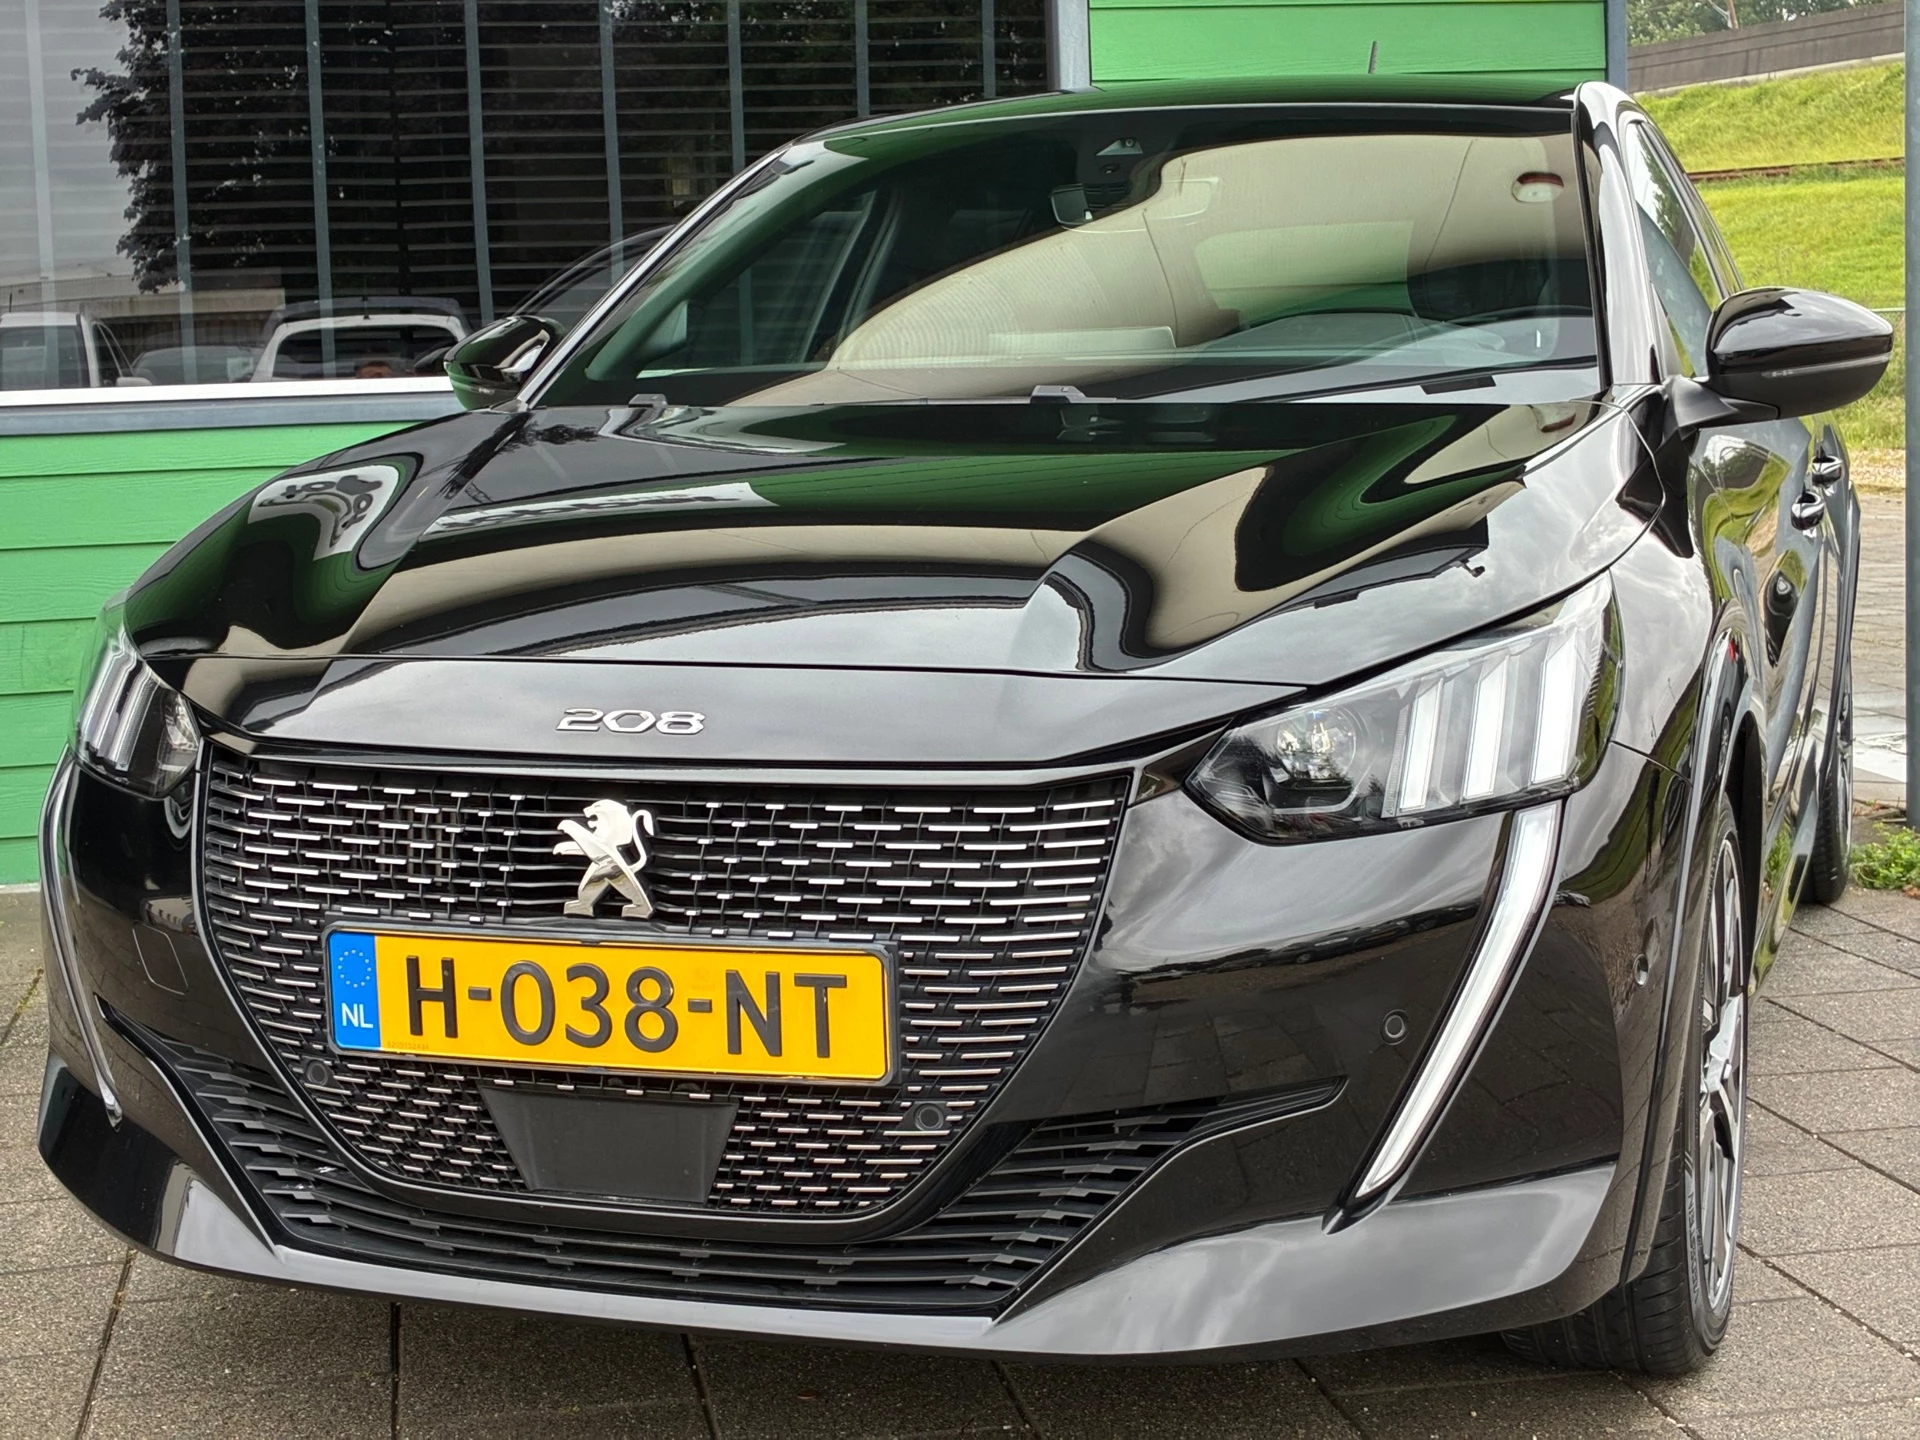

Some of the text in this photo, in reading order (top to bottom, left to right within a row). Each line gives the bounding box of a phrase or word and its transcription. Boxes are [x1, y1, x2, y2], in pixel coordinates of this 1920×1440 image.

[555, 708, 706, 735] 208
[341, 1002, 374, 1029] NL
[405, 955, 848, 1058] H-038-NT
